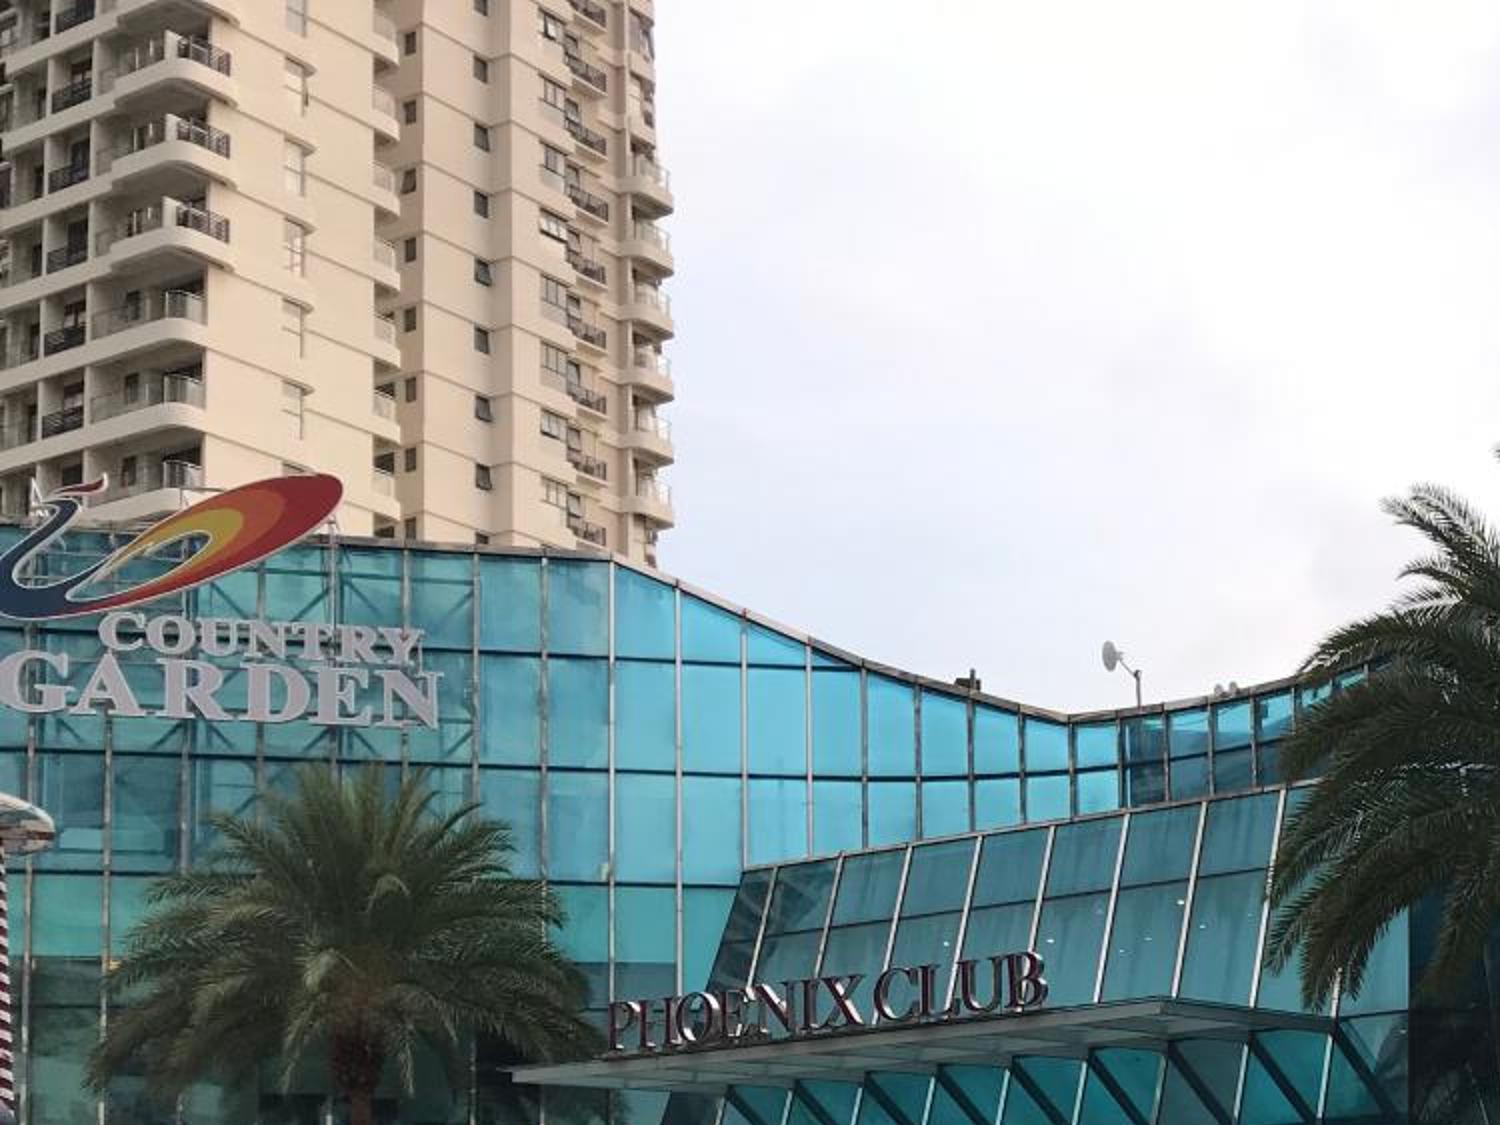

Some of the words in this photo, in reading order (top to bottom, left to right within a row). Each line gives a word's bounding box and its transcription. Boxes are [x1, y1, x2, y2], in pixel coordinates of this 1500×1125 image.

[99, 611, 425, 666] COUNTRY
[0, 649, 443, 730] GARDEN
[610, 973, 867, 1051] PHOENIX
[874, 951, 1050, 1023] CLUB
